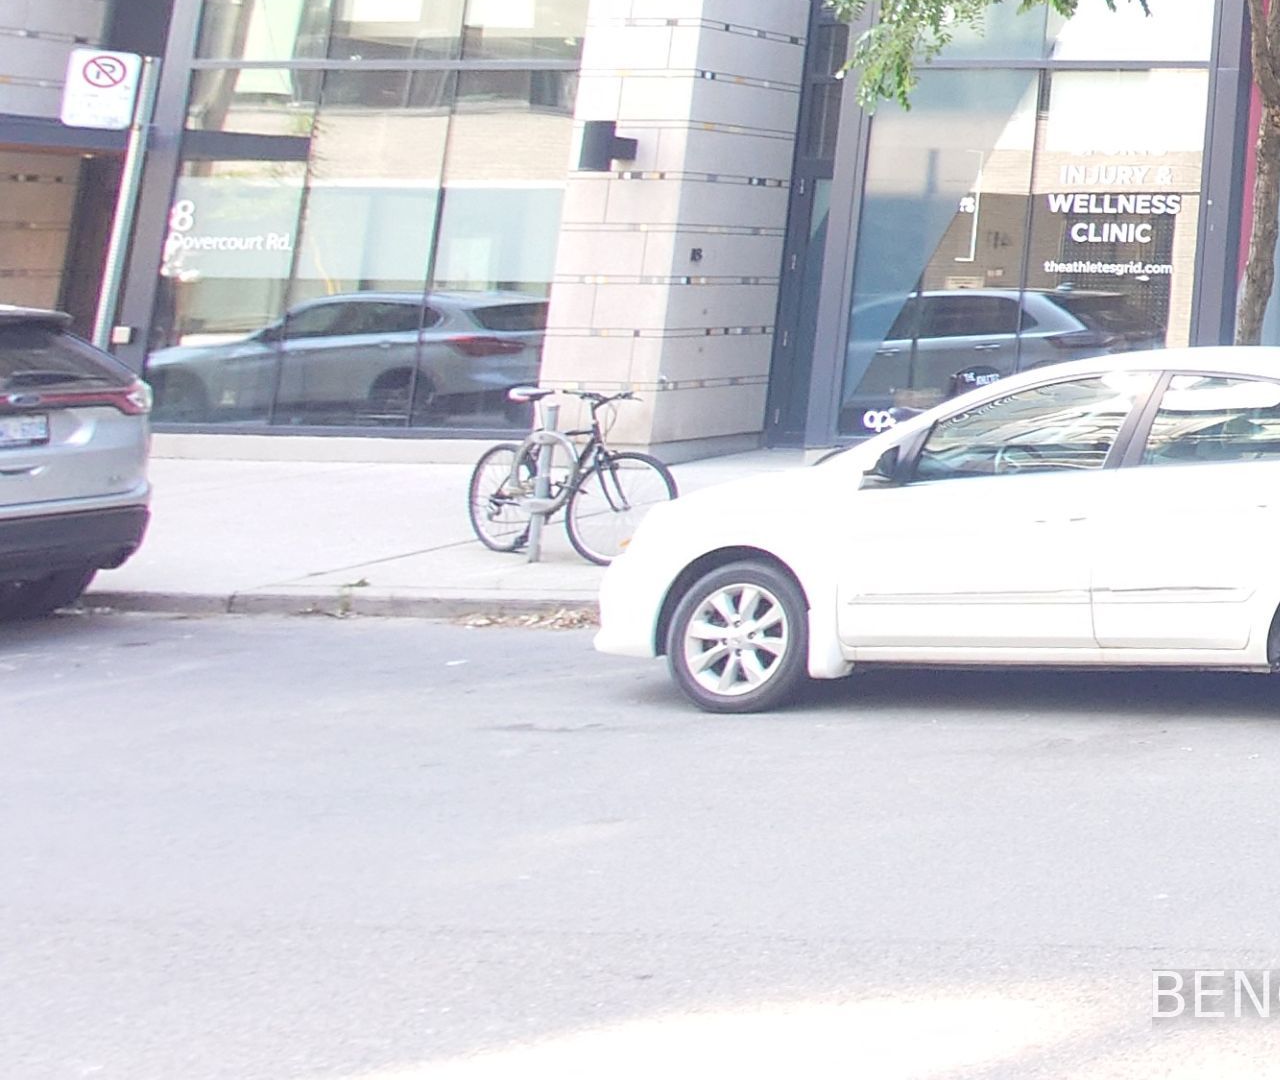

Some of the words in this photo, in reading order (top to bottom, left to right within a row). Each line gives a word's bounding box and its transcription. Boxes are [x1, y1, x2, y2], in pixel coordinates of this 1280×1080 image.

[1059, 165, 1150, 185] INJURY
[1047, 194, 1182, 215] WELLNESS
[170, 200, 195, 231] 8
[167, 232, 264, 251] Dovercourt
[1070, 222, 1153, 243] CLINIC
[1043, 261, 1173, 276] theathletesgrid.com
